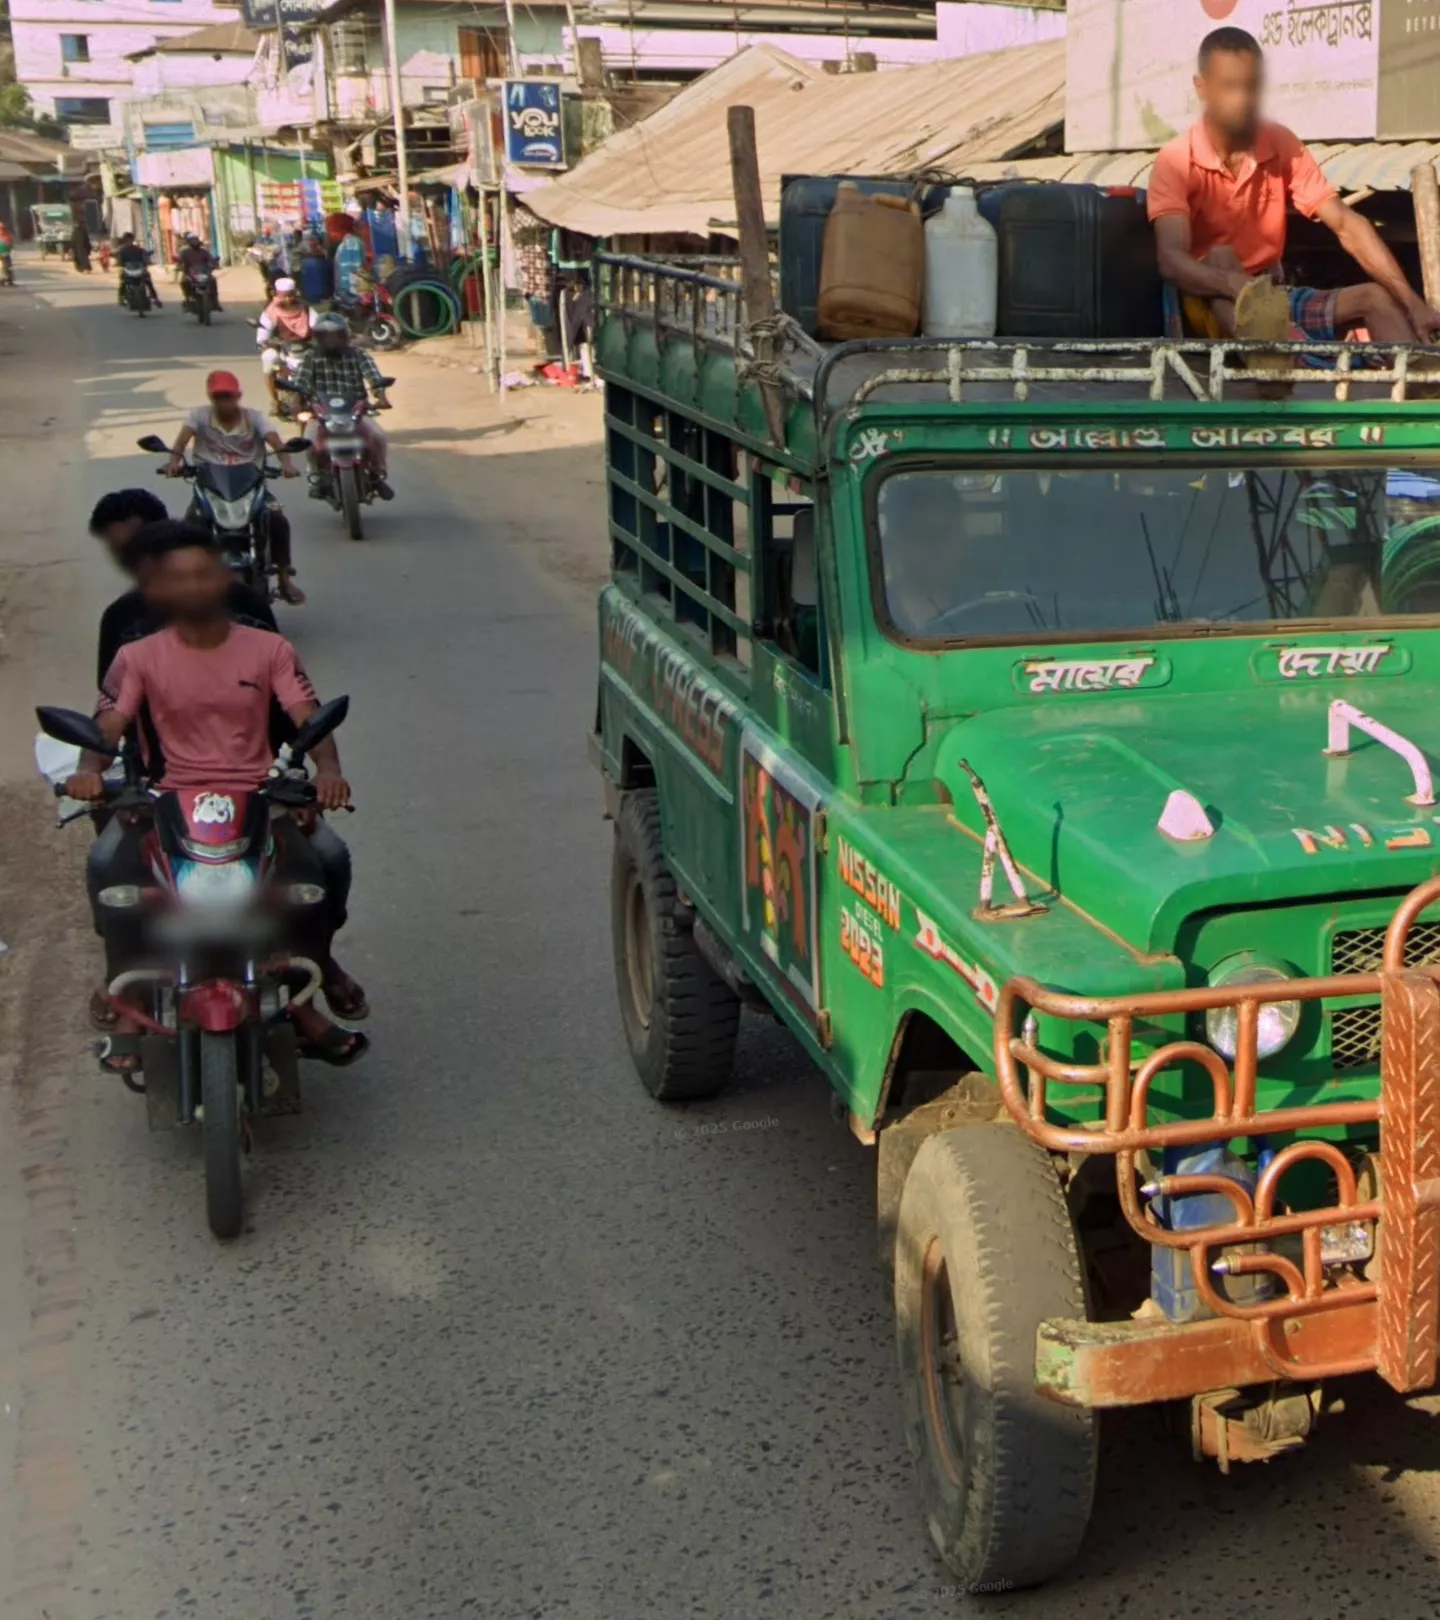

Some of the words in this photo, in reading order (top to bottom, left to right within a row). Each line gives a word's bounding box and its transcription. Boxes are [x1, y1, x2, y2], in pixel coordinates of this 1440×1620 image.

[1024, 657, 1157, 692] মায়ের
[1278, 644, 1395, 678] দোয়া
[838, 834, 902, 935] NISSAN
